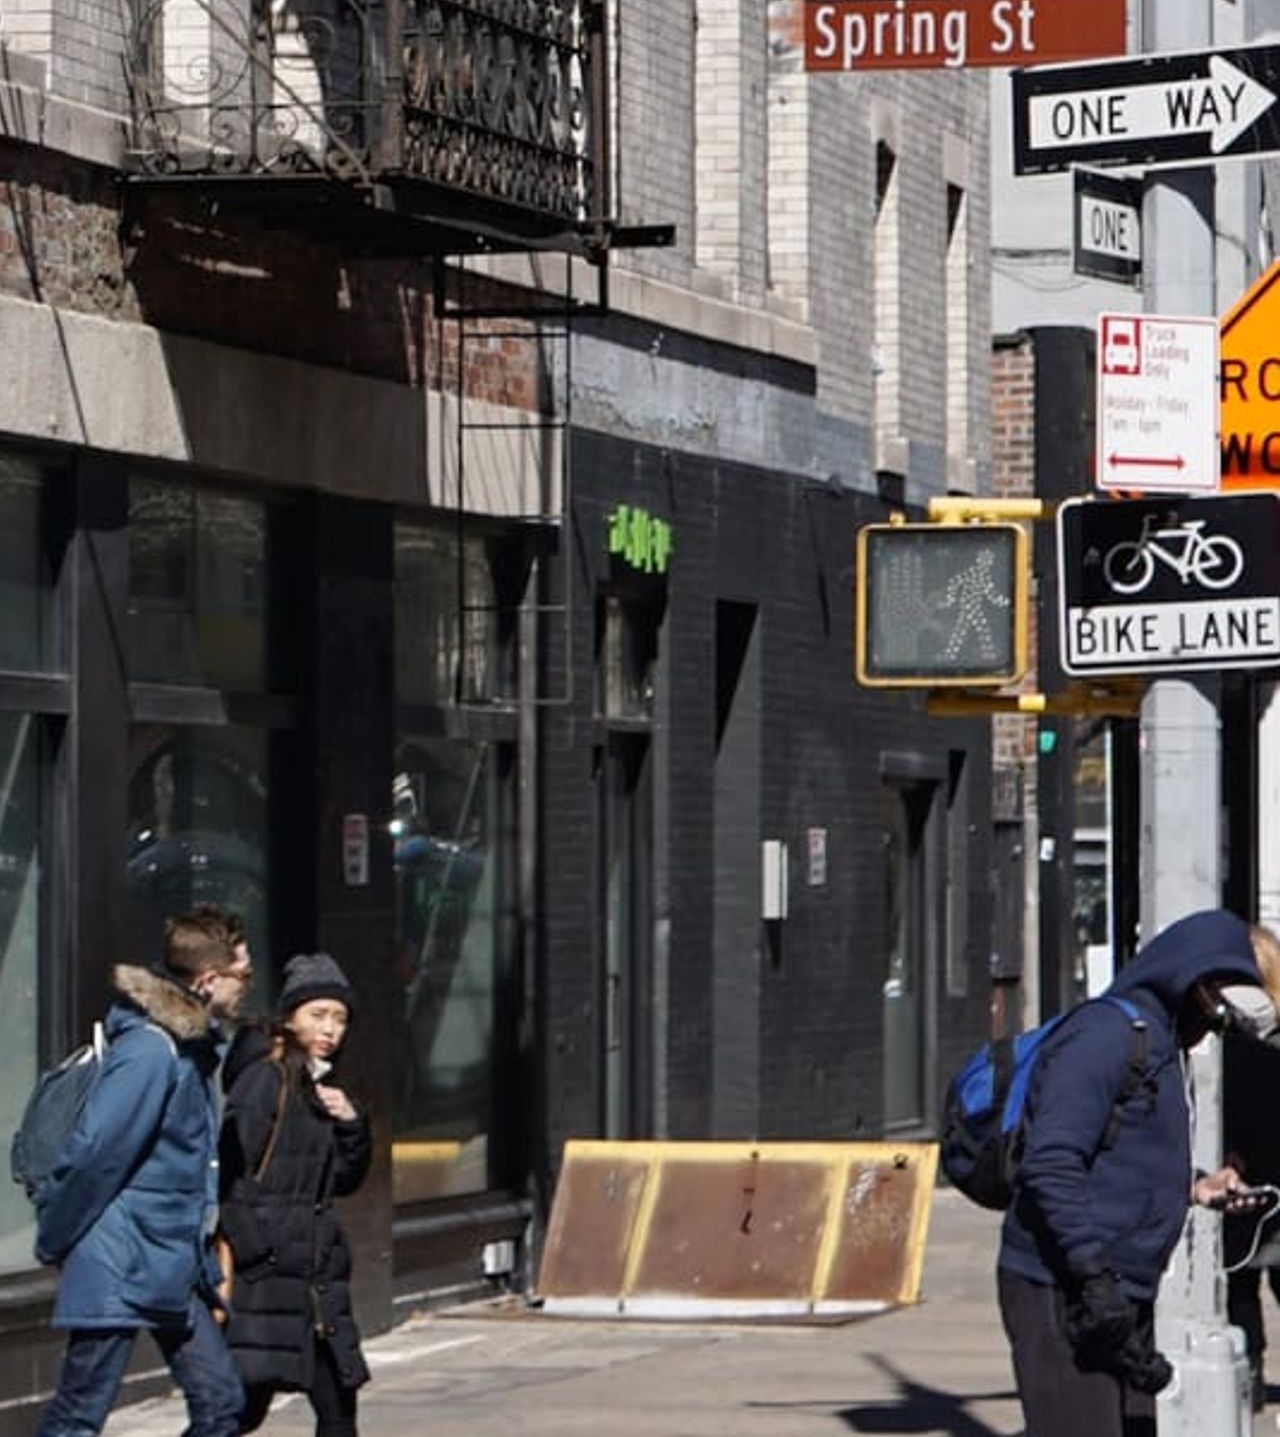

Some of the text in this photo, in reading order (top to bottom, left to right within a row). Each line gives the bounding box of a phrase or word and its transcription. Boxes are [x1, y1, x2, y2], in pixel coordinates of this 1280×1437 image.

[813, 0, 968, 69] Spring
[1052, 83, 1246, 140] ONE WAY
[1091, 205, 1128, 252] ONE
[1077, 607, 1274, 656] BIKE LANE
